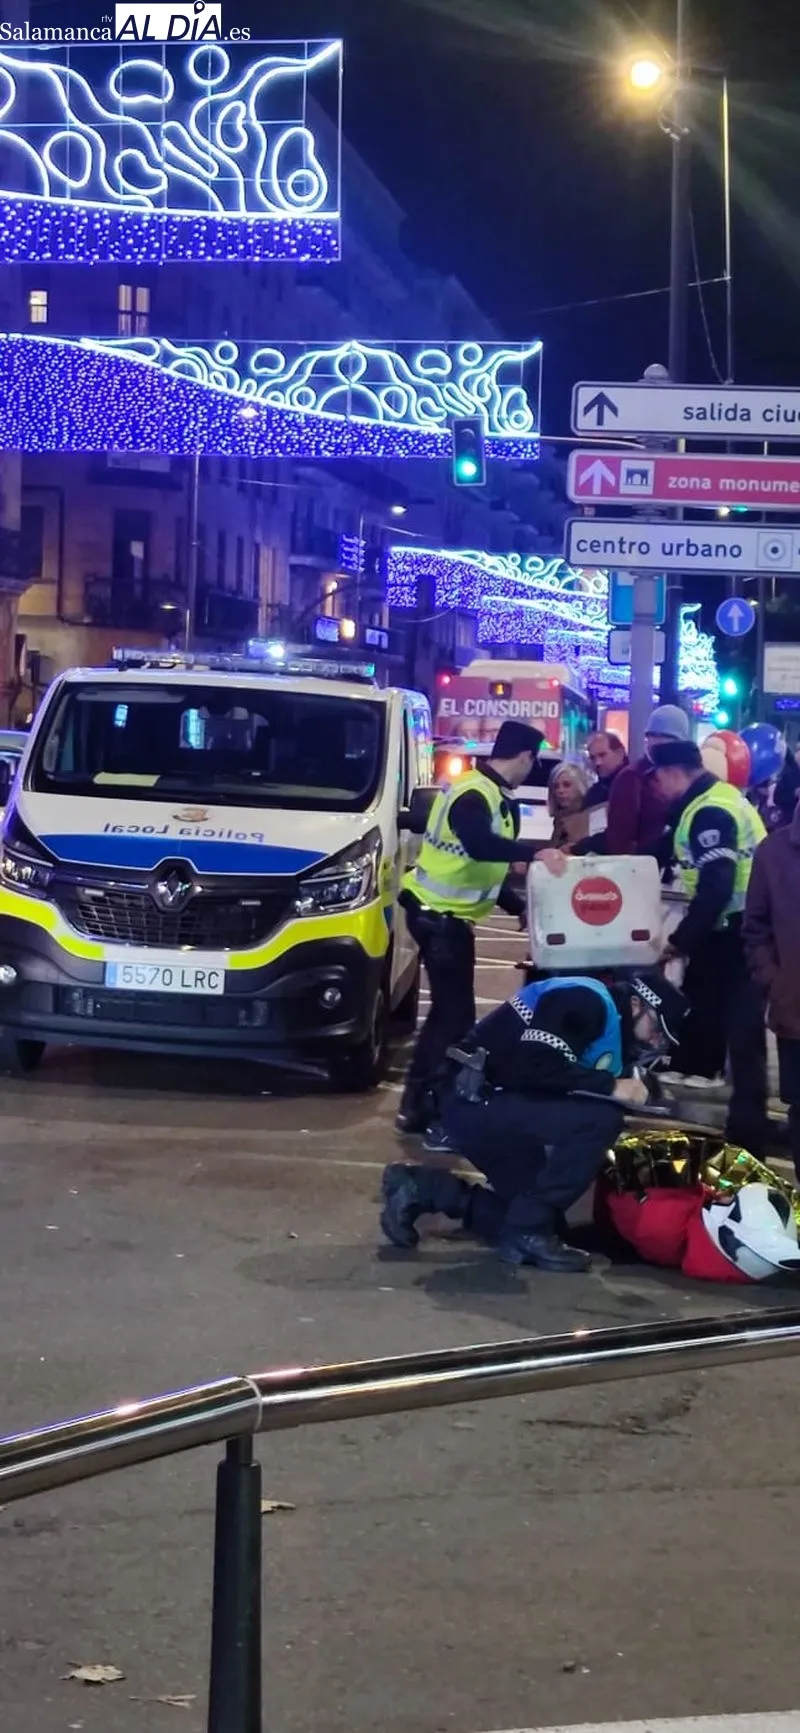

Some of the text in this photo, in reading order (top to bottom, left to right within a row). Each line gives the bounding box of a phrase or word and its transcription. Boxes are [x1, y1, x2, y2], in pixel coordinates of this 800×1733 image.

[682, 402, 800, 424] salida ciu
[667, 475, 712, 490] zona
[576, 536, 742, 558] centro urbano
[439, 698, 559, 718] EL CONSORCIO
[121, 966, 220, 989] 5570 LRC
